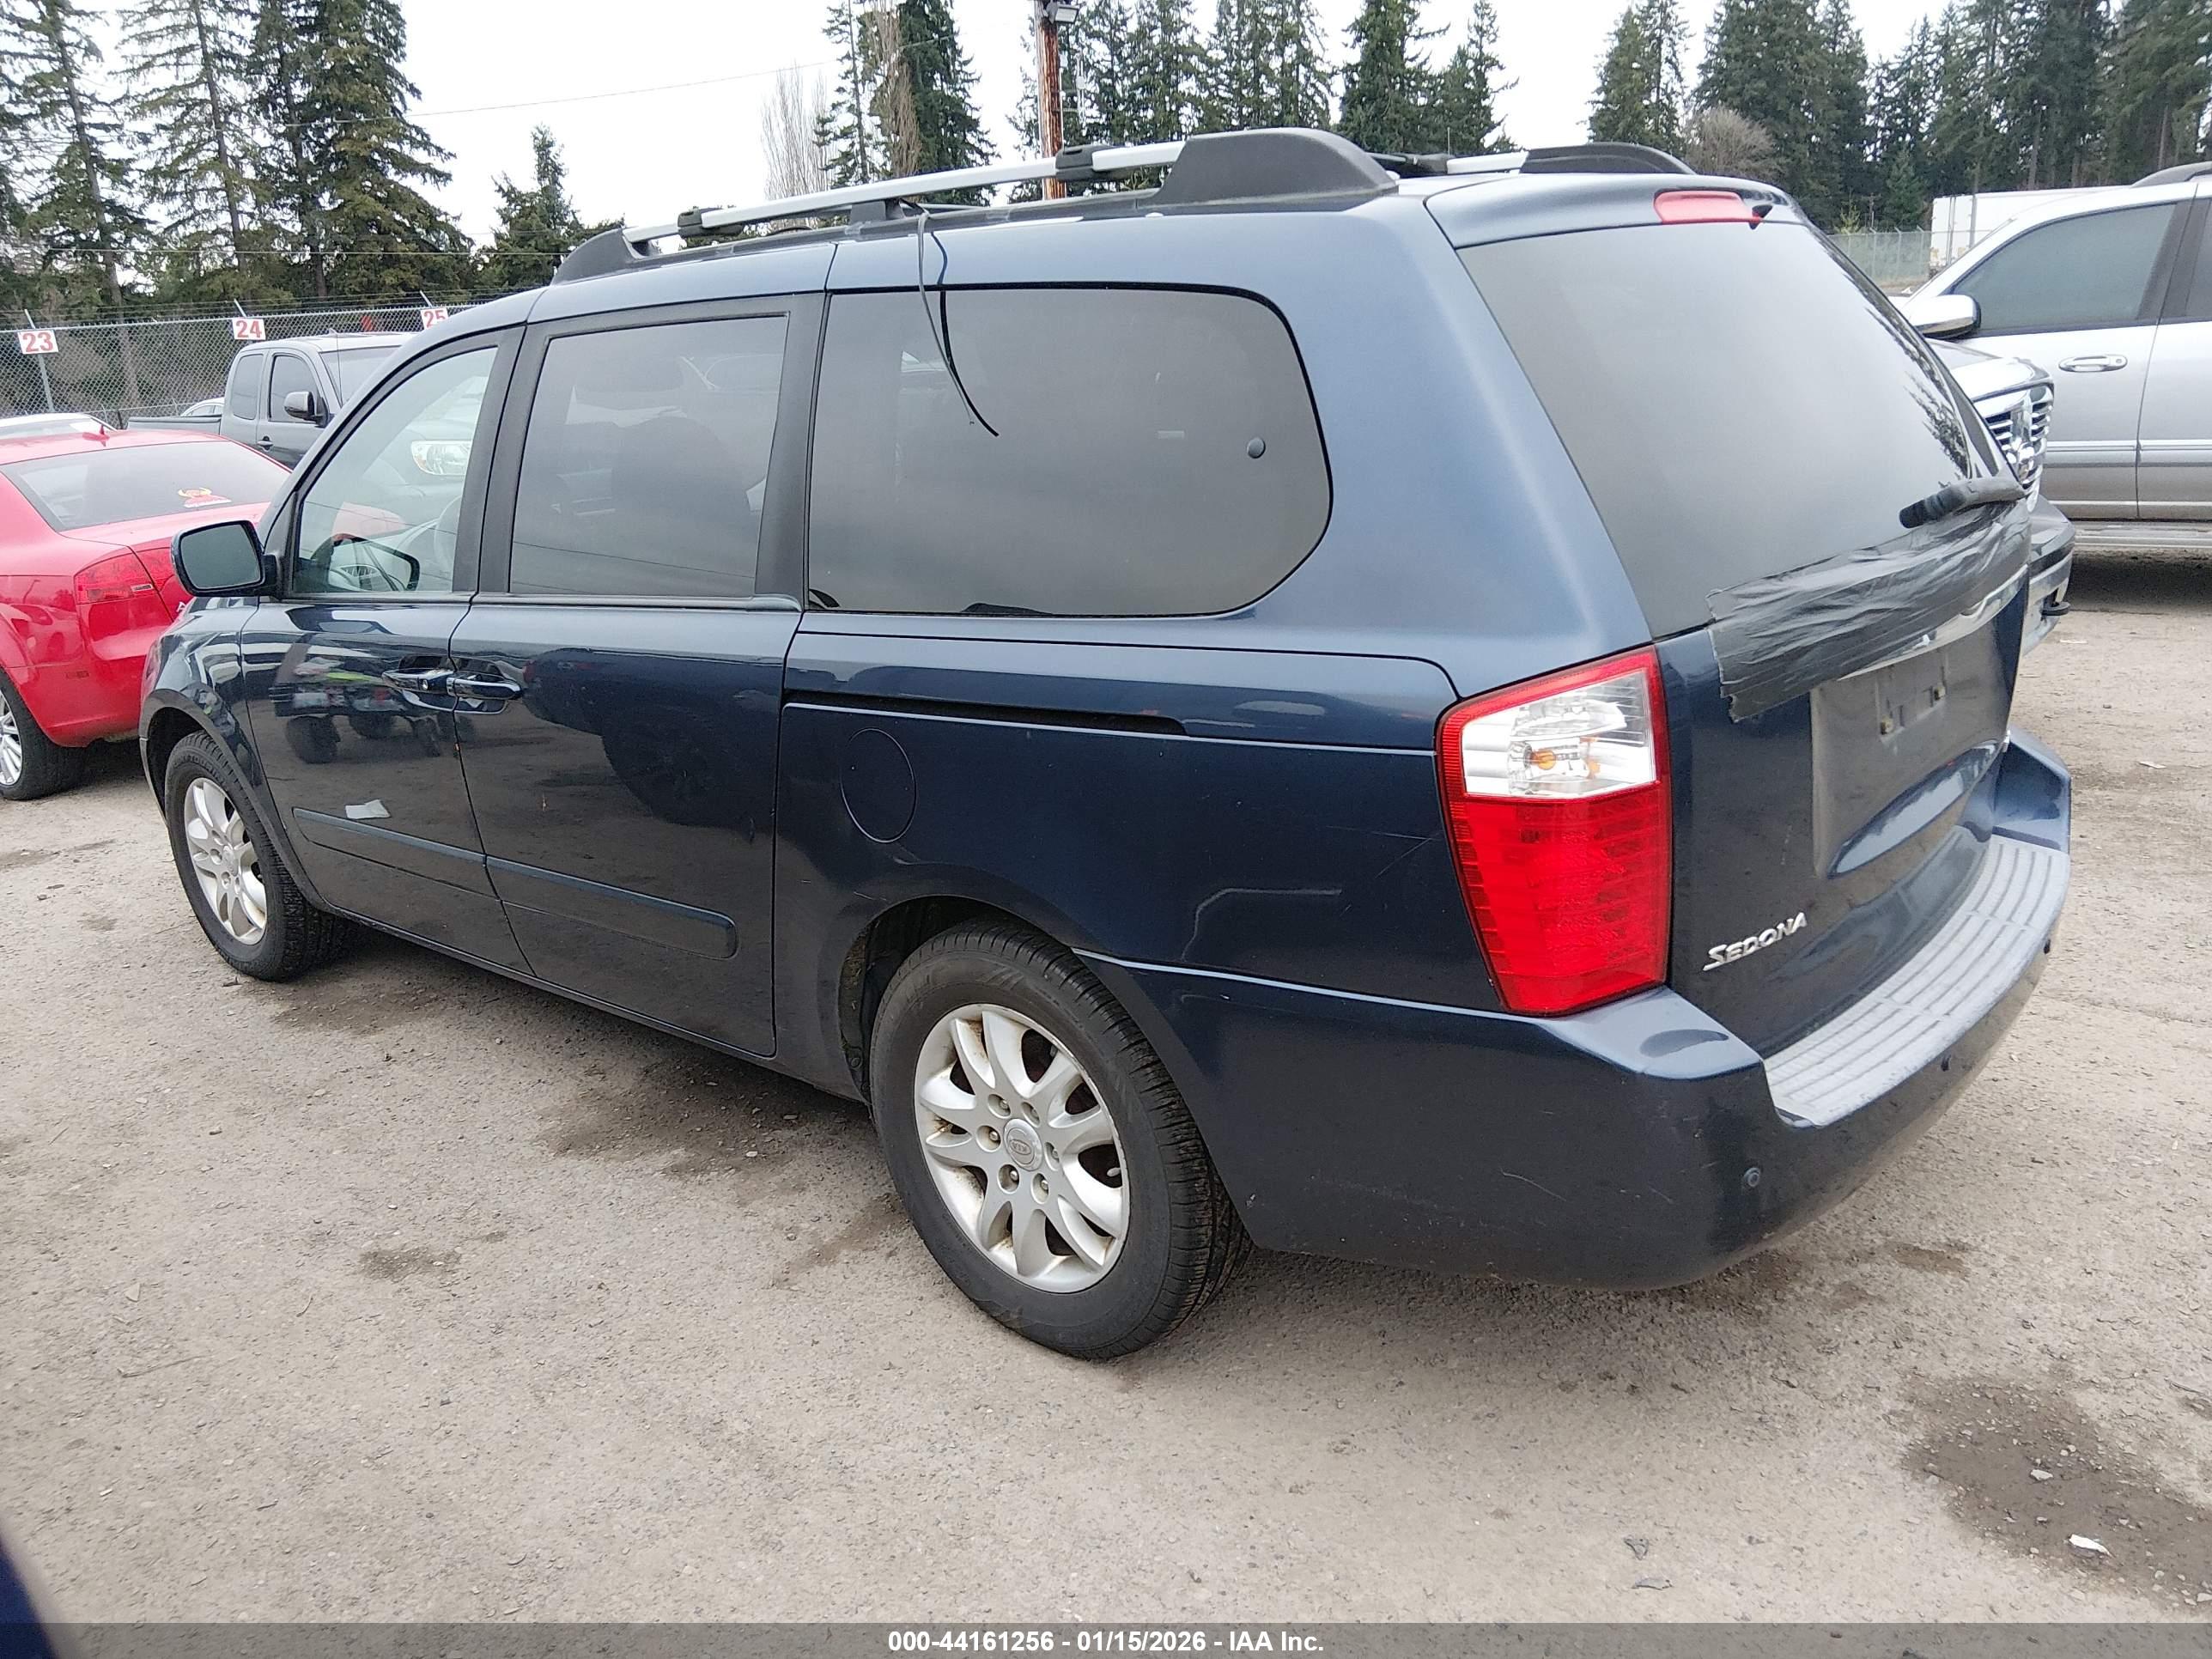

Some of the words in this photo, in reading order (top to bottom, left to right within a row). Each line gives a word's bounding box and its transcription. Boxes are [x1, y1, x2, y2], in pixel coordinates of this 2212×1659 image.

[235, 319, 263, 338] 24
[22, 331, 54, 352] 23
[1702, 911, 1808, 972] SEDONA
